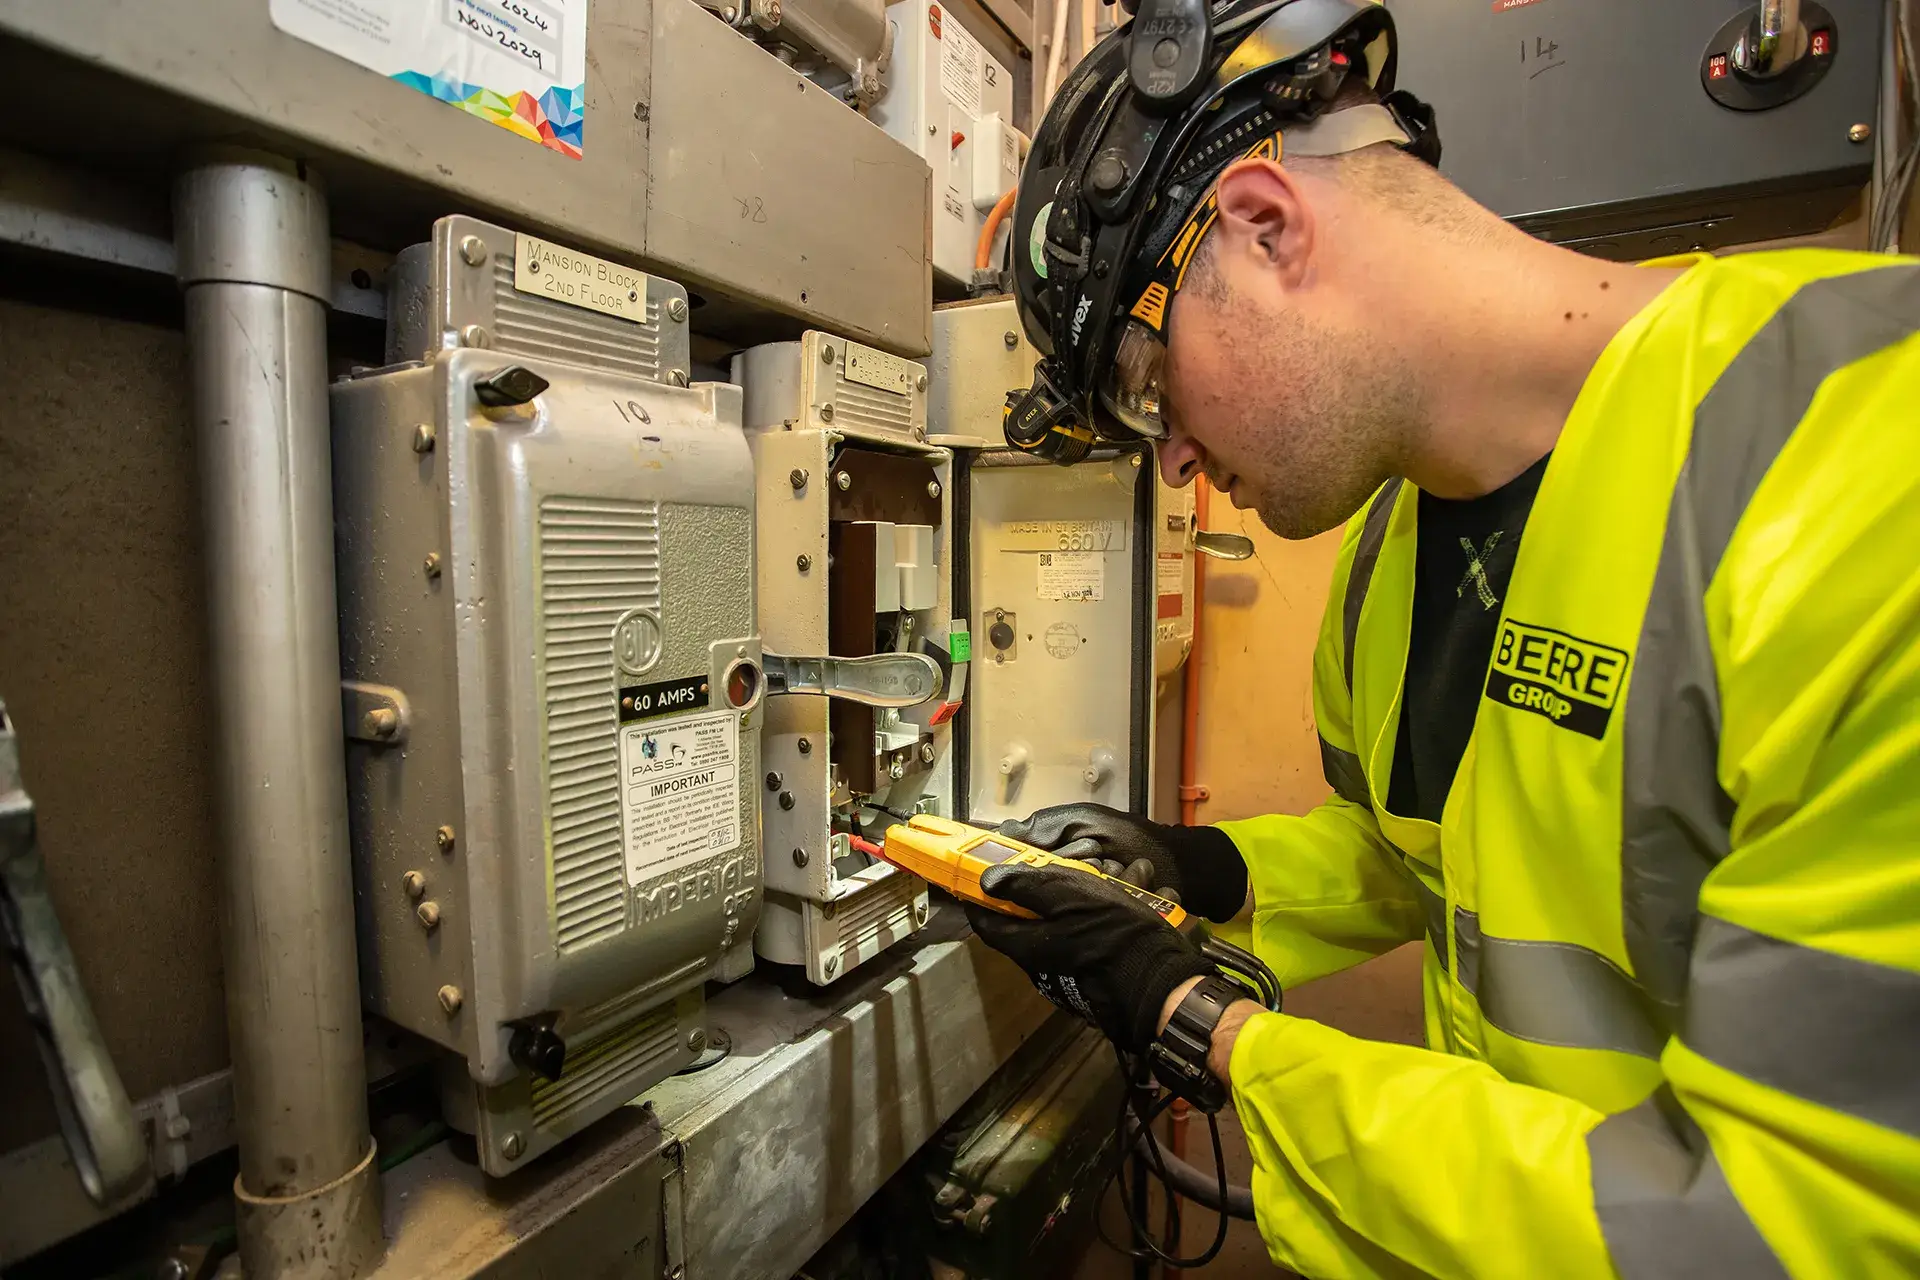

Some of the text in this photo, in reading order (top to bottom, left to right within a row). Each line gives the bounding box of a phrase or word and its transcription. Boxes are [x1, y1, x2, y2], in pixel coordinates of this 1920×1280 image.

[458, 10, 542, 69] NOV 2029
[1143, 18, 1176, 36] 2797
[1521, 36, 1558, 63] 14
[1710, 56, 1725, 67] 100
[1713, 66, 1721, 77] A
[1146, 80, 1176, 94] K2P
[527, 240, 639, 291] MANSION BLOCK
[544, 273, 623, 310] 2ND FLOOR
[1071, 294, 1093, 347] uvex
[612, 399, 651, 425] 10
[1025, 407, 1038, 422] ATEX
[1059, 532, 1112, 551] 660 V
[1496, 628, 1617, 700] BEERE
[634, 687, 695, 711] 60 AMPS
[632, 758, 674, 777] PASS
[650, 770, 714, 797] IMPORTANT
